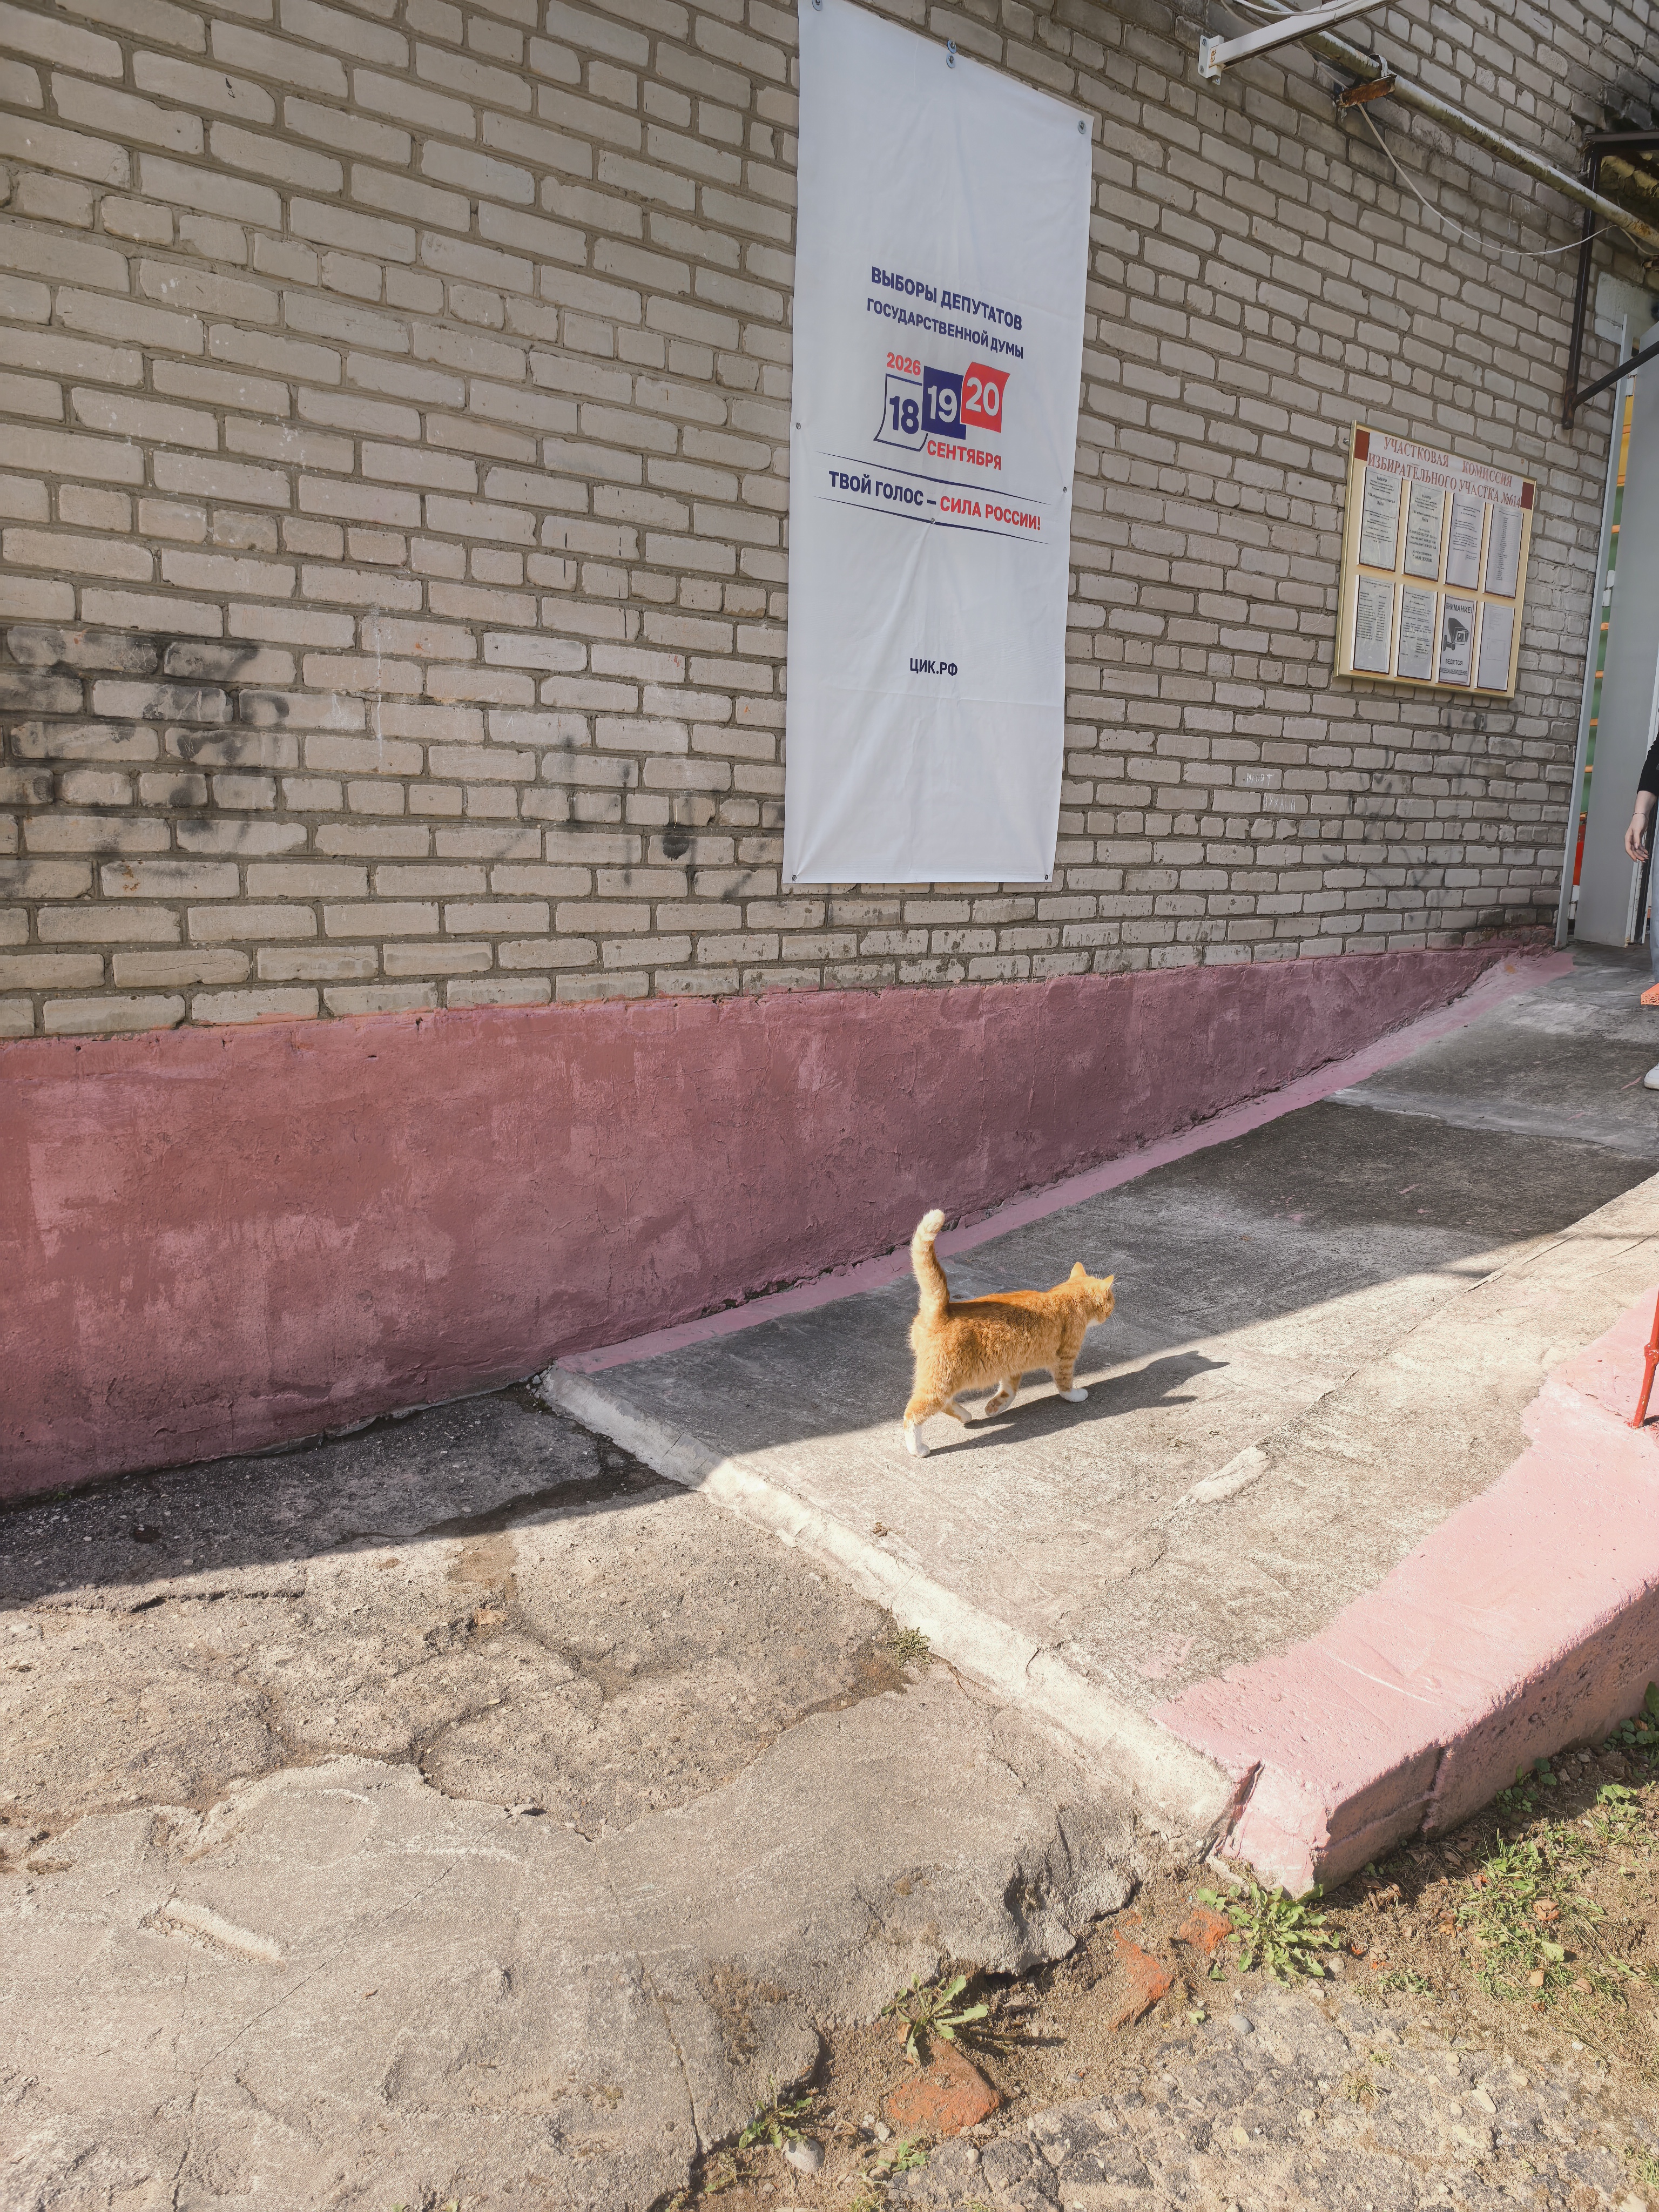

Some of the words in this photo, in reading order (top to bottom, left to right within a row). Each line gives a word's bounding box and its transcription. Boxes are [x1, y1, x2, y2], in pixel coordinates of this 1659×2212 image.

[872, 266, 937, 303] ВЫБОРЫ
[940, 290, 1022, 331] ДЕПУТАТОВ
[867, 298, 988, 347] ГОСУДАРСТВЕННОЙ
[990, 336, 1023, 359] ДУМЫ
[886, 352, 921, 376] 2026
[889, 395, 919, 435] 18
[927, 385, 957, 423] 19
[966, 377, 999, 416] 20
[927, 440, 1002, 470] СЕНТЯБРЯ
[1367, 453, 1457, 490] ИЗБИРАТЕЛЬНОГО
[1459, 479, 1499, 503] УЧАСТКА
[1500, 492, 1521, 509] №614
[1384, 436, 1449, 467] УЧАСТКОВАЯ
[1461, 460, 1513, 488] КОМИССИЯ
[828, 470, 872, 495] ТВОЙ
[875, 482, 924, 506] ГОЛОС
[940, 496, 982, 517] СИЛА
[985, 504, 1041, 531] РОССИИ!
[1446, 602, 1473, 614] ВНИМАНИЕ!
[909, 658, 958, 676] ЦИК.РФ
